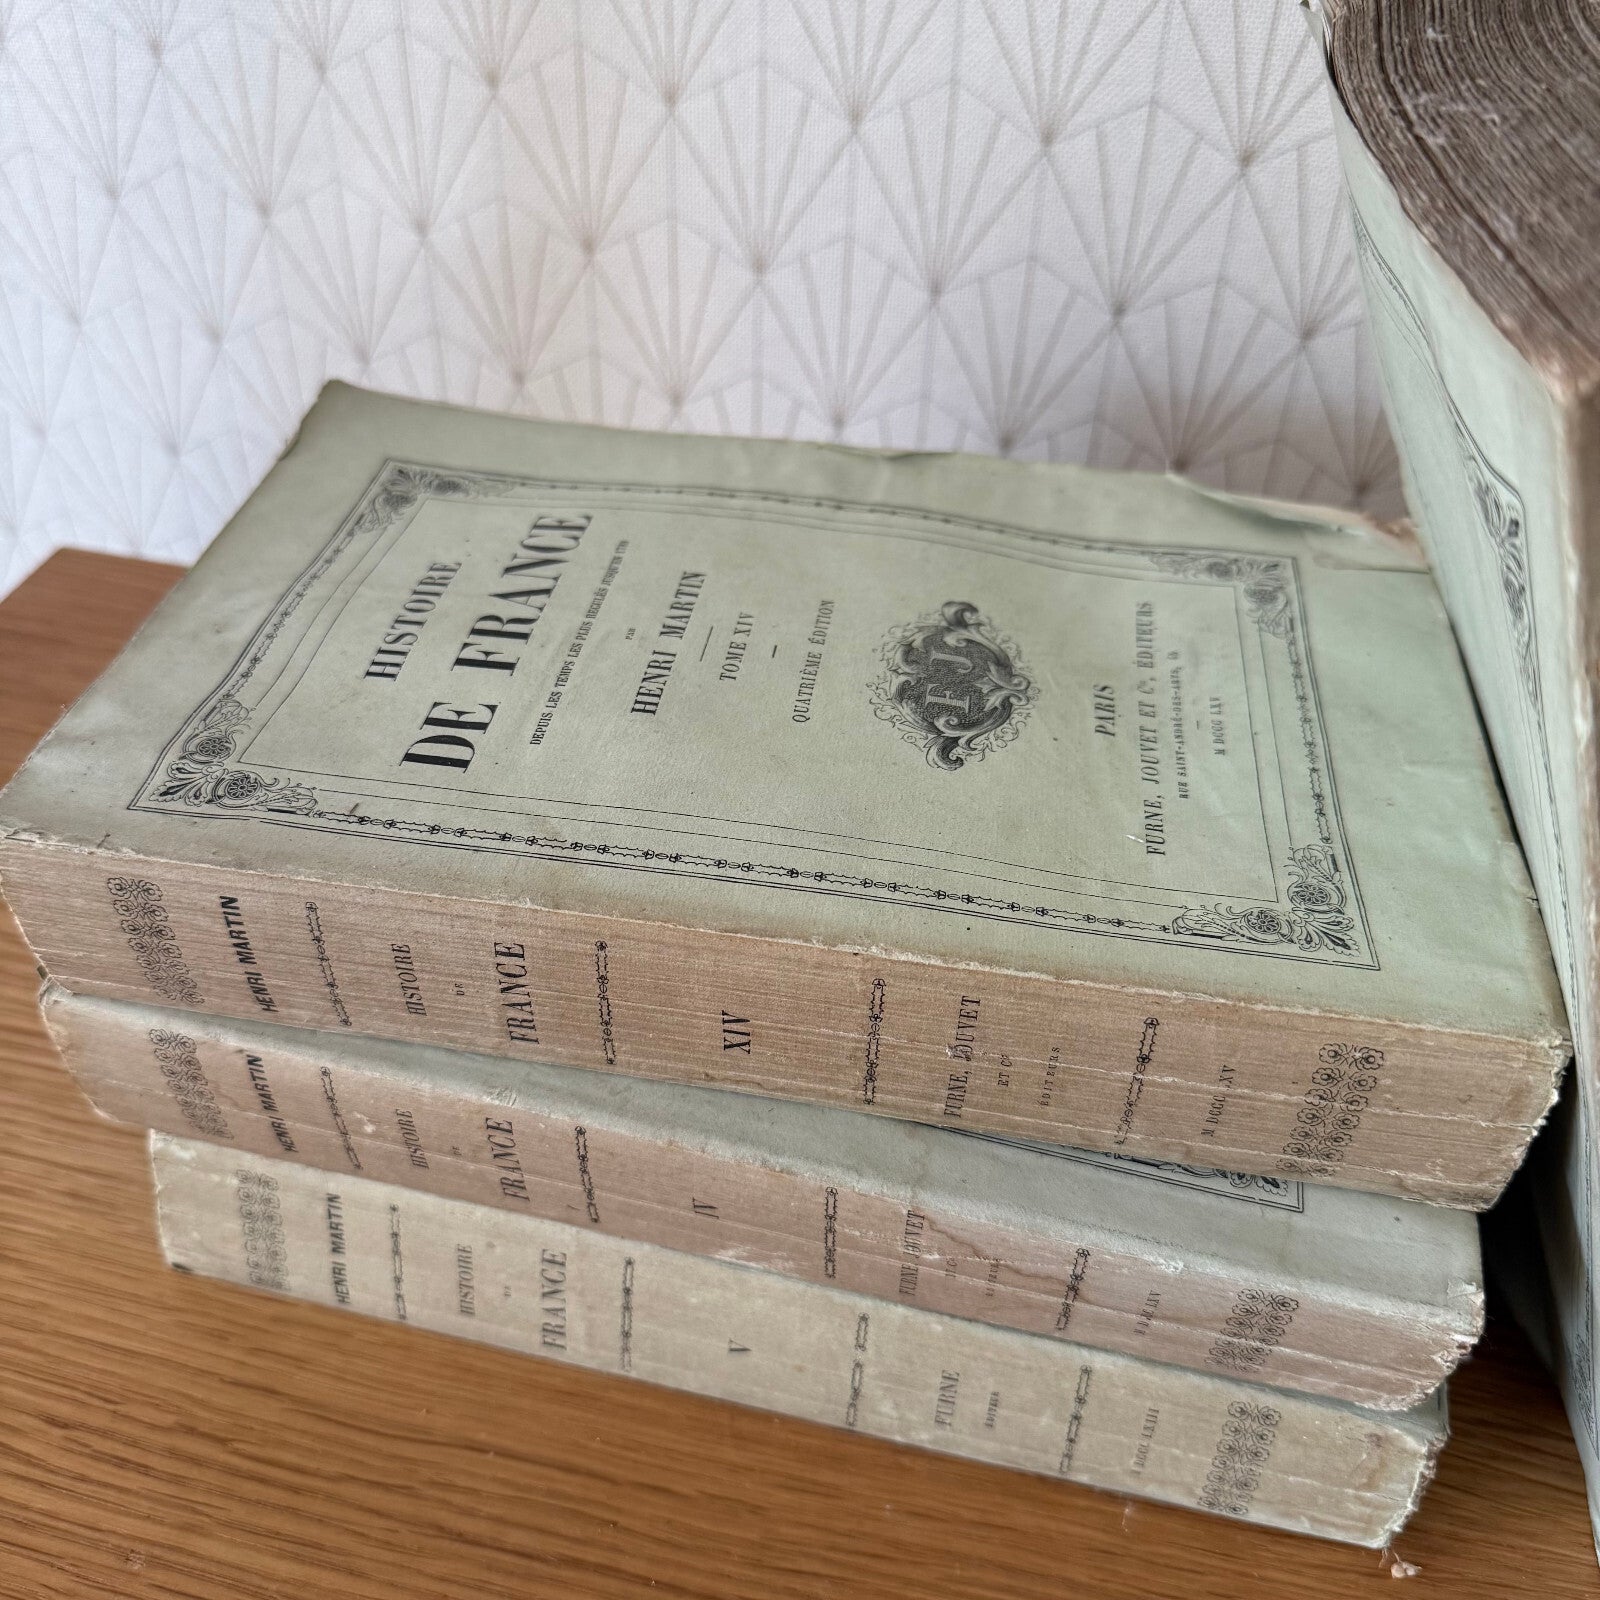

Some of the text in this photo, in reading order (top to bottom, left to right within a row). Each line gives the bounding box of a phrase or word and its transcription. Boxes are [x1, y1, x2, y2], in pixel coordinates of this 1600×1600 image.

[363, 562, 463, 682] HISTOIRE
[399, 515, 593, 774] DE FRANCE
[569, 640, 584, 658] LES
[576, 621, 592, 642] PLUS
[625, 627, 636, 640] PAR
[630, 571, 707, 716] HENRI MARTIN
[720, 612, 754, 681] TOME XIV
[1133, 601, 1154, 669] ÉDITEURS
[554, 660, 576, 689] TEMPS
[792, 600, 835, 723] QUATRIÈME ÉDITION
[530, 712, 553, 746] DEPUIS
[546, 691, 563, 710] LES
[1093, 684, 1116, 737] PARIS
[1138, 701, 1157, 718] ET
[1210, 697, 1222, 716] LXV
[1139, 726, 1160, 785] JOUVET
[1179, 782, 1189, 799] RUE
[1144, 795, 1166, 856] FURNE,
[220, 896, 279, 1013] HENRI MARTIN
[391, 944, 427, 1016] HISTOIRE
[451, 983, 465, 996] DE
[494, 942, 539, 1045] FRANCE
[721, 1009, 750, 1055] XIV
[943, 995, 981, 1118] FURNE, JOUVET
[247, 1055, 298, 1153] HENRI MARTIN
[998, 1072, 1011, 1087] ET
[1038, 1047, 1061, 1107] ÉDITEURS
[395, 1109, 429, 1169] HISTOIRE
[1201, 1127, 1214, 1137] M
[1206, 1095, 1226, 1125] DCCC
[486, 1117, 530, 1201] FRANCE
[691, 1197, 719, 1219] IV
[903, 1210, 925, 1259] JOUVET
[326, 1193, 350, 1304] HENRI MARTIN
[456, 1243, 476, 1316] HISTOIRE
[541, 1248, 567, 1351] FRANCE
[727, 1338, 752, 1352] V
[934, 1369, 960, 1427] FURNE
